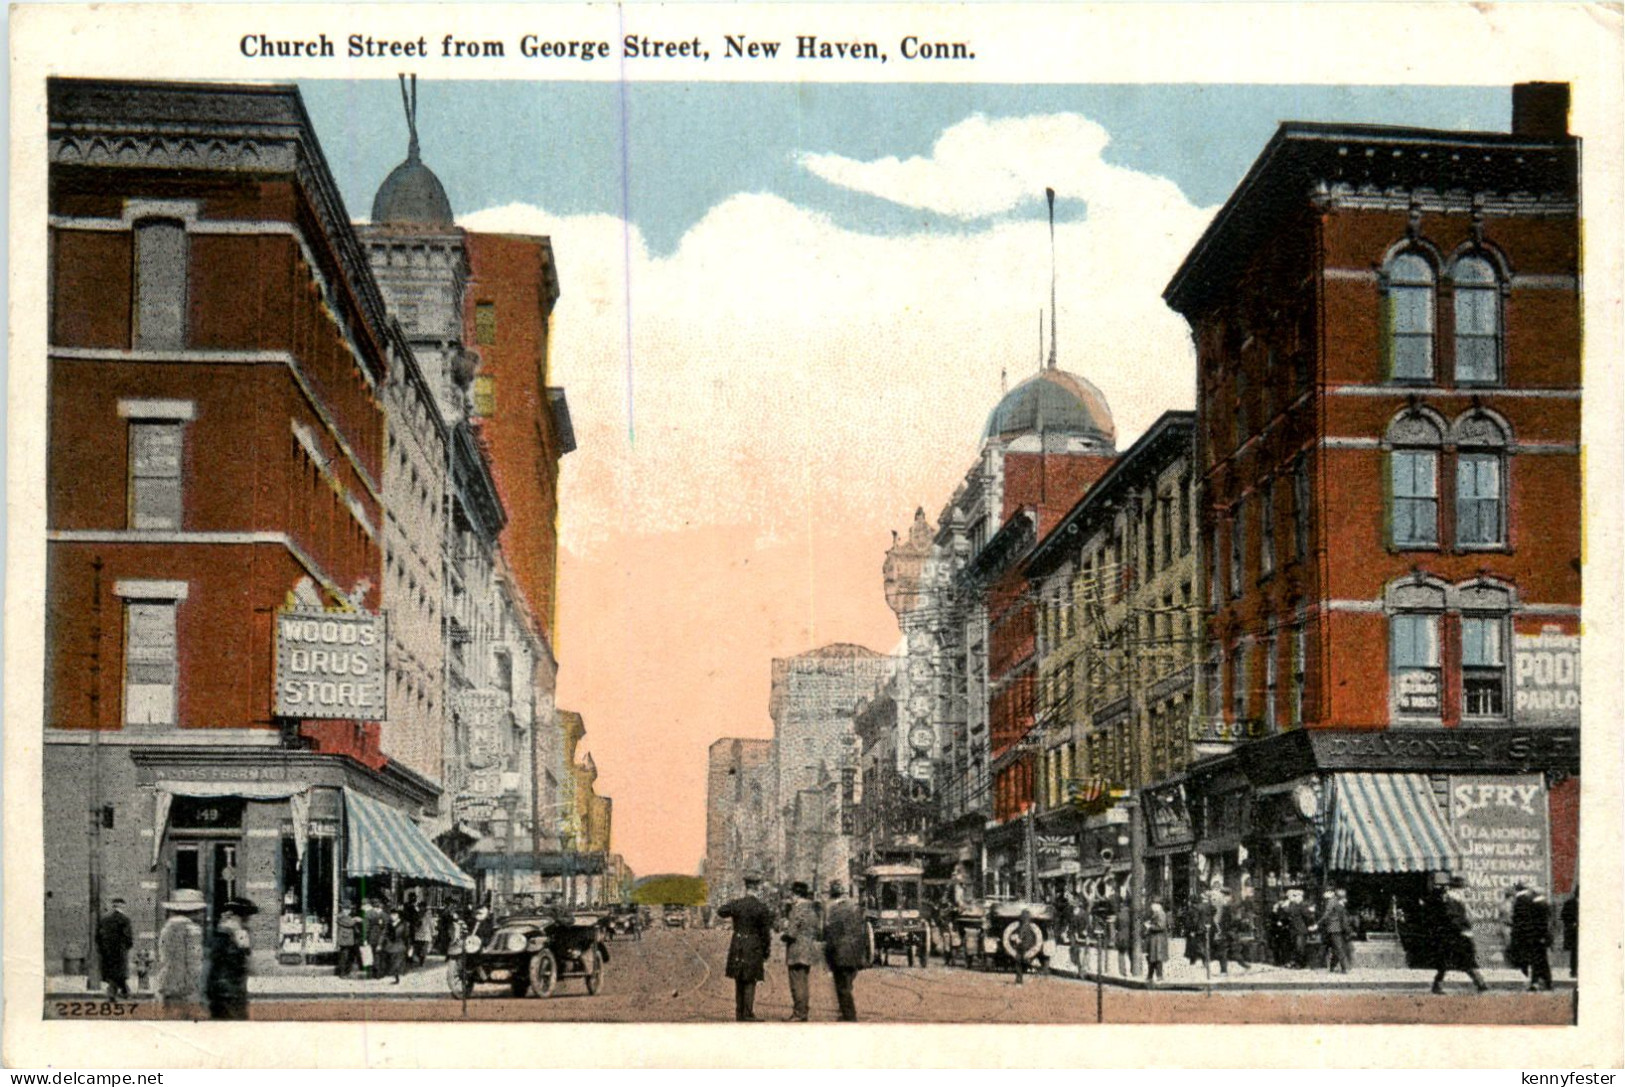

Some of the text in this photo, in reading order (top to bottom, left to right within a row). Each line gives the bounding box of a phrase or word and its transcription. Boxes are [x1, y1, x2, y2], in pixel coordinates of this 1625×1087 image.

[284, 620, 376, 646] WOODS
[284, 681, 374, 707] STORE
[1459, 824, 1541, 841] DIAMONDS
